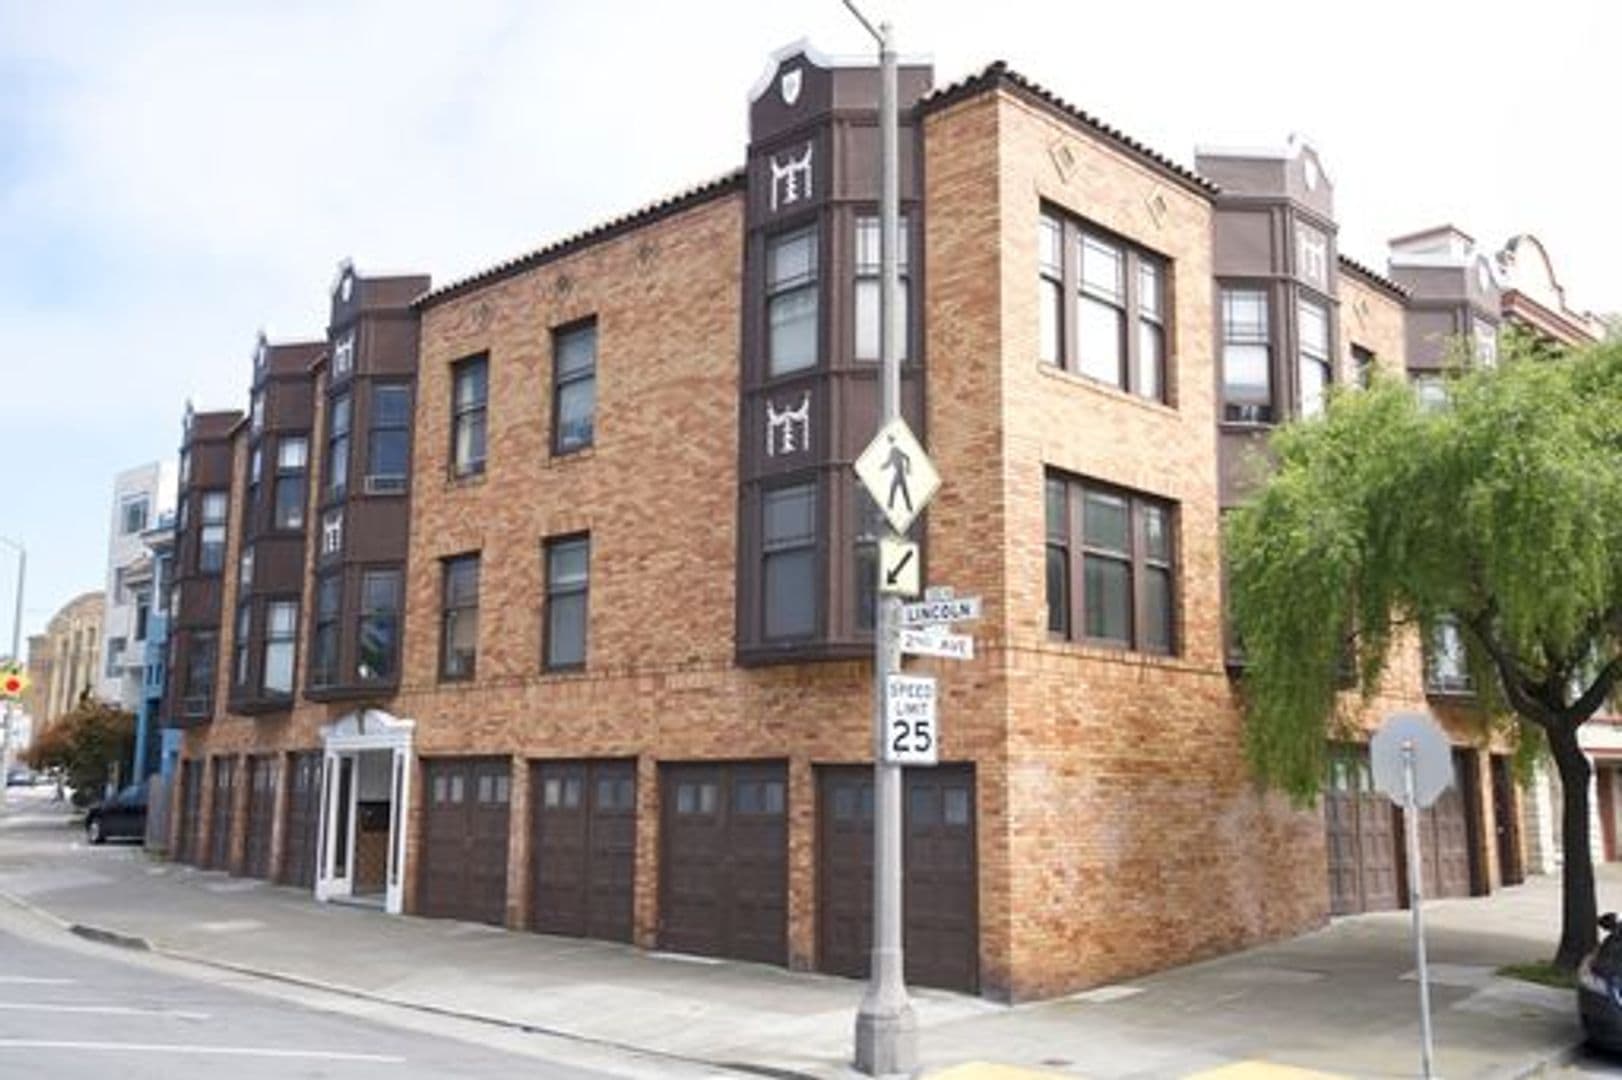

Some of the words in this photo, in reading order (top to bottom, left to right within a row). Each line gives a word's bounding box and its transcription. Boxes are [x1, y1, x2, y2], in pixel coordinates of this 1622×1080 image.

[908, 603, 971, 621] LINCOLN
[889, 683, 931, 698] SPEED
[895, 701, 929, 717] LIMIT
[893, 720, 932, 752] 25
